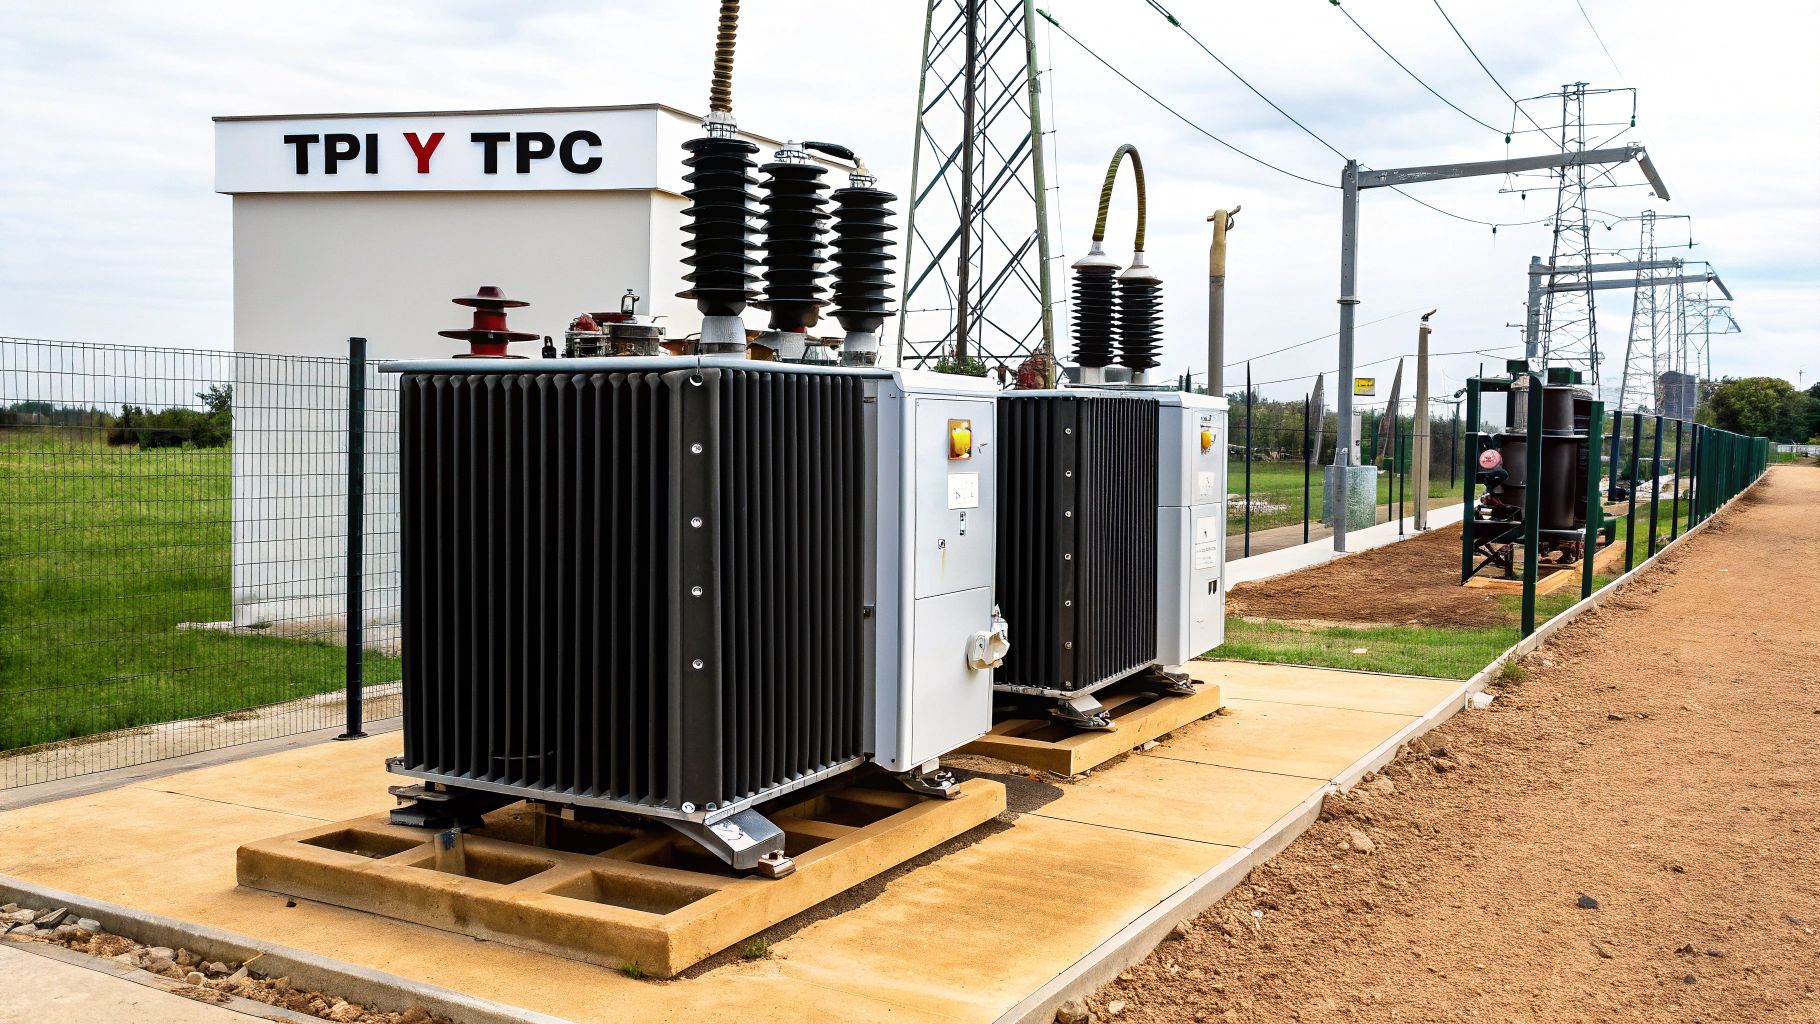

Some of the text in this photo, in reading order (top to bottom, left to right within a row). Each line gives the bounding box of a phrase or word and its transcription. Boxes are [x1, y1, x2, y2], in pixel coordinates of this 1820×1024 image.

[284, 130, 603, 175] TPI Y TPC
